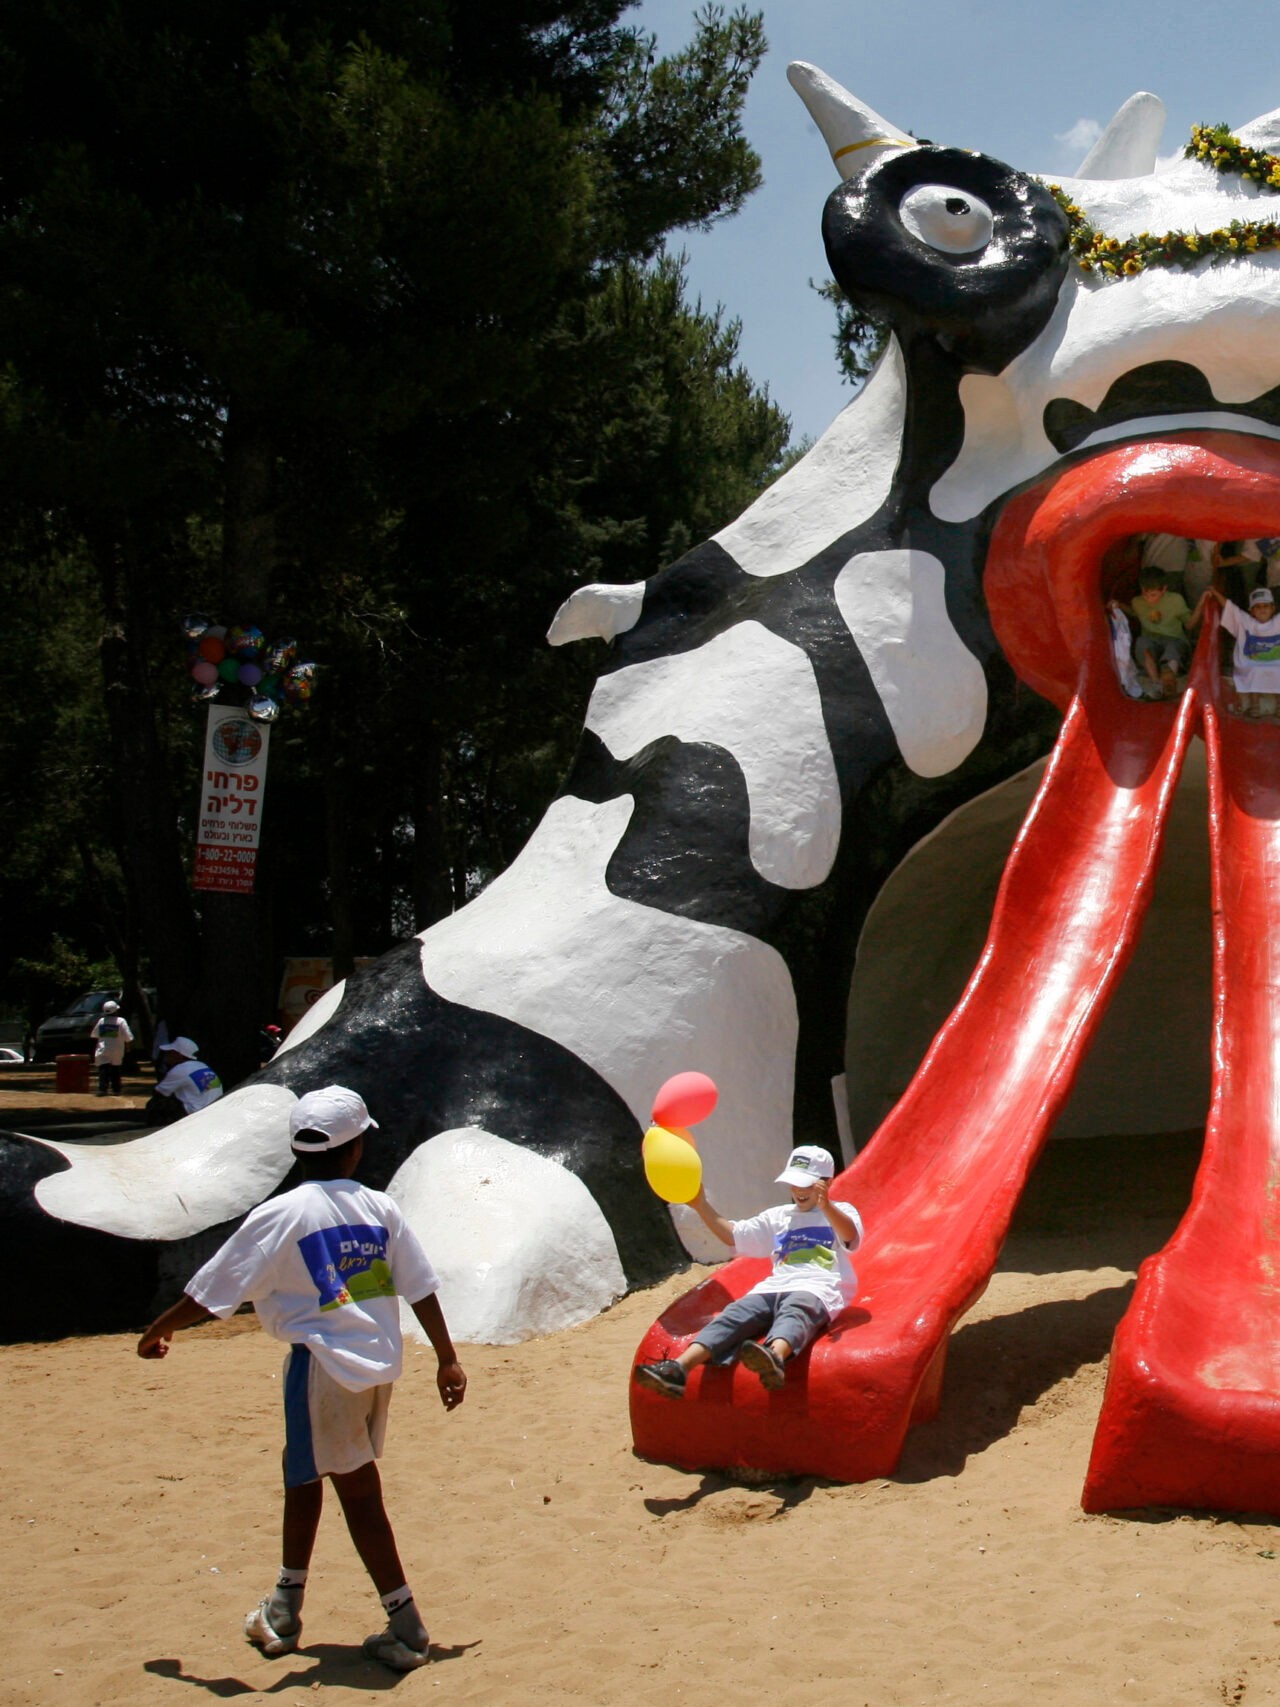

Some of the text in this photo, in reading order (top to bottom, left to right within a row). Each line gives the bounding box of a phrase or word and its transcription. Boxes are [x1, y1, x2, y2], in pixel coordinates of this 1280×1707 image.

[207, 771, 259, 791] פרחי
[207, 793, 257, 816] דליה
[201, 819, 258, 832] משלוחי פרחים
[204, 830, 253, 842] בארץ ובעולם
